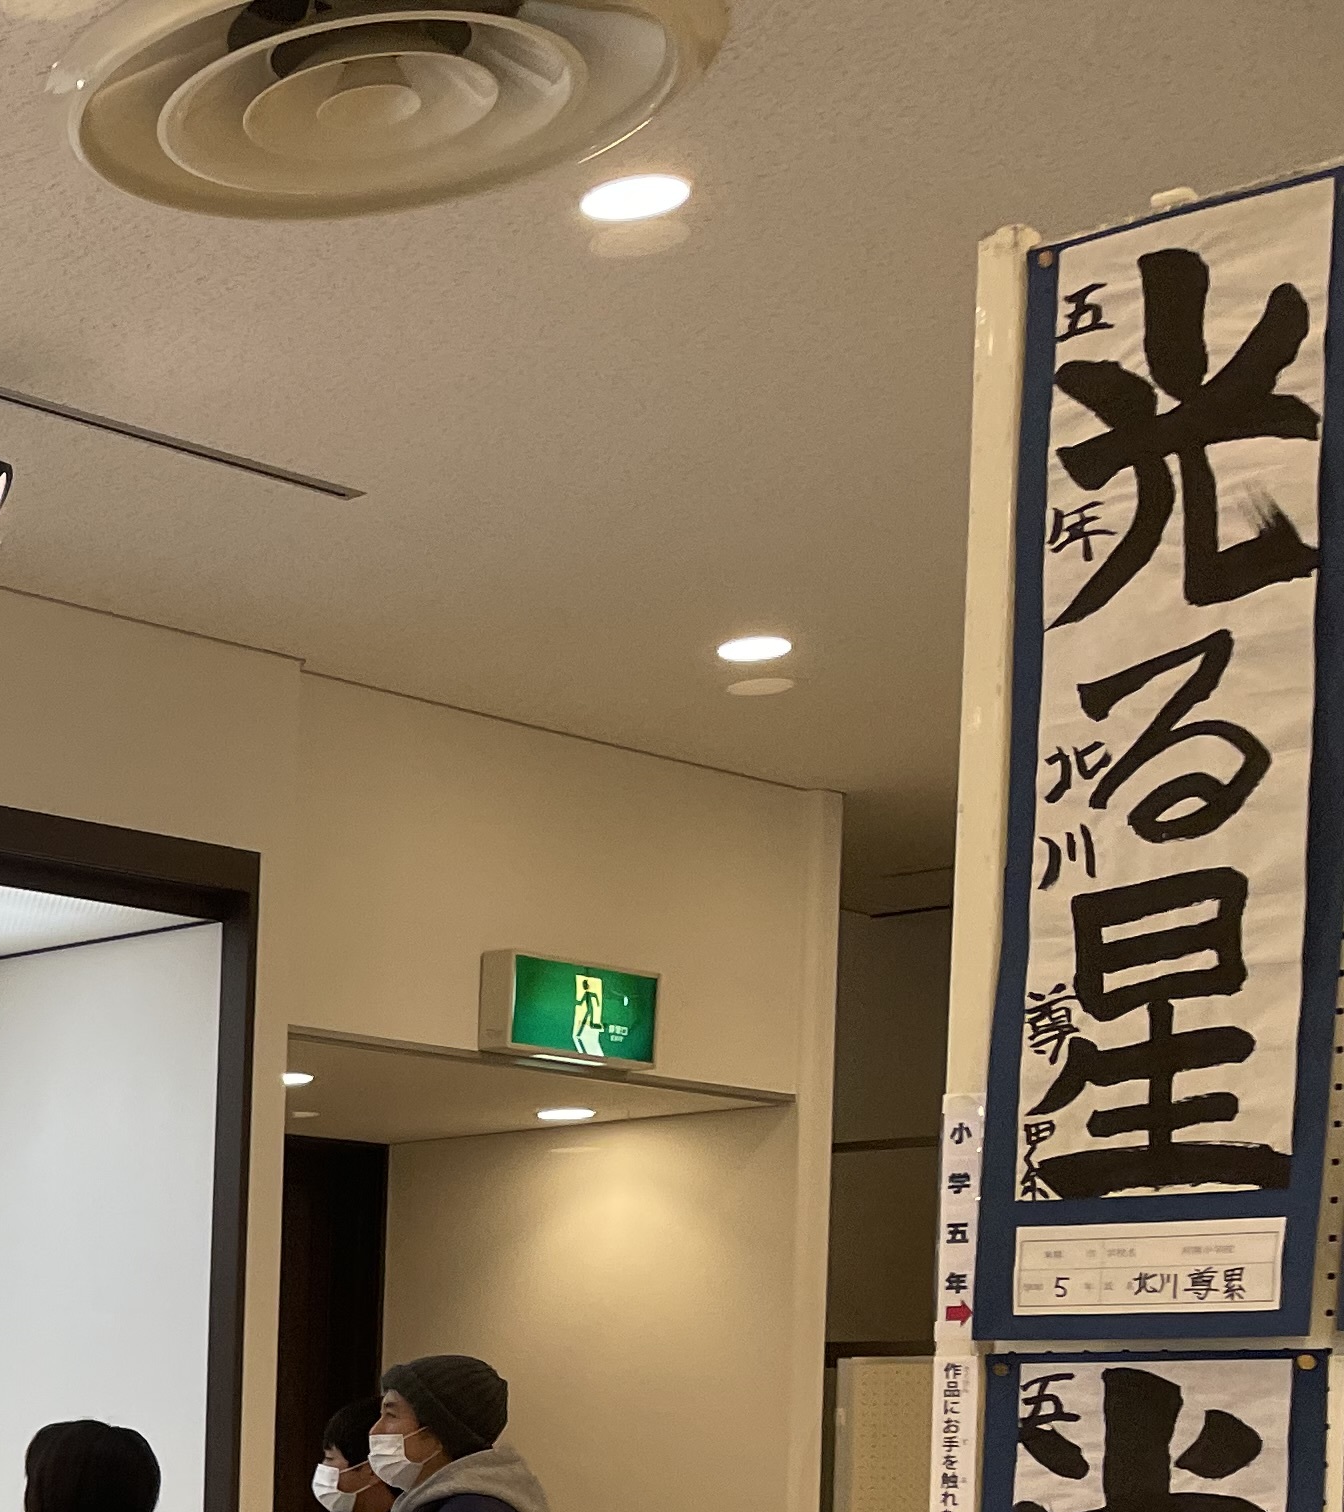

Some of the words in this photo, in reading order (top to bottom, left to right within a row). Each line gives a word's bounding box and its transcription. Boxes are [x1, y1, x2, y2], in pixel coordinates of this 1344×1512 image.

[1026, 248, 1321, 1200] 光る星
[944, 1122, 973, 1294] 小学五年
[1054, 1276, 1070, 1298] 5
